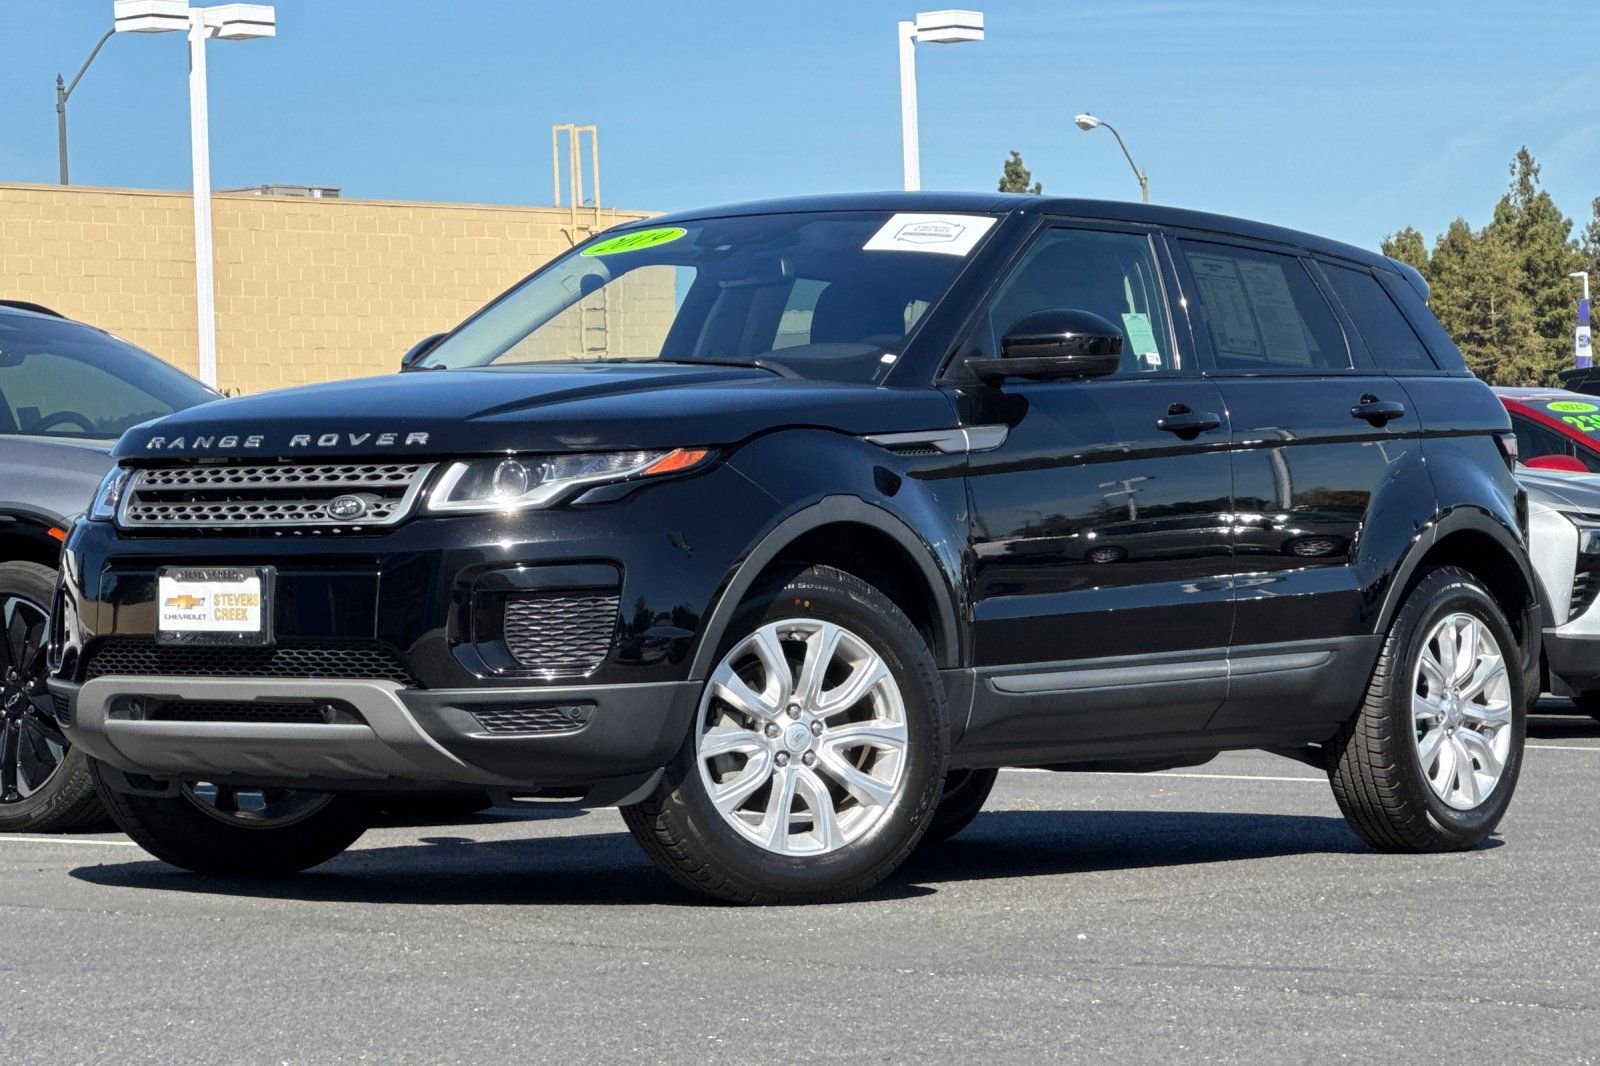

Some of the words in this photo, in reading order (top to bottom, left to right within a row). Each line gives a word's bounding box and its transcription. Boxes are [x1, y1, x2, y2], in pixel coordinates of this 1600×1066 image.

[146, 435, 264, 449] RANGE
[289, 431, 430, 447] ROVER
[213, 593, 258, 606] STEVENS
[164, 613, 207, 621] CHEVROLET
[214, 608, 248, 621] CREEK
